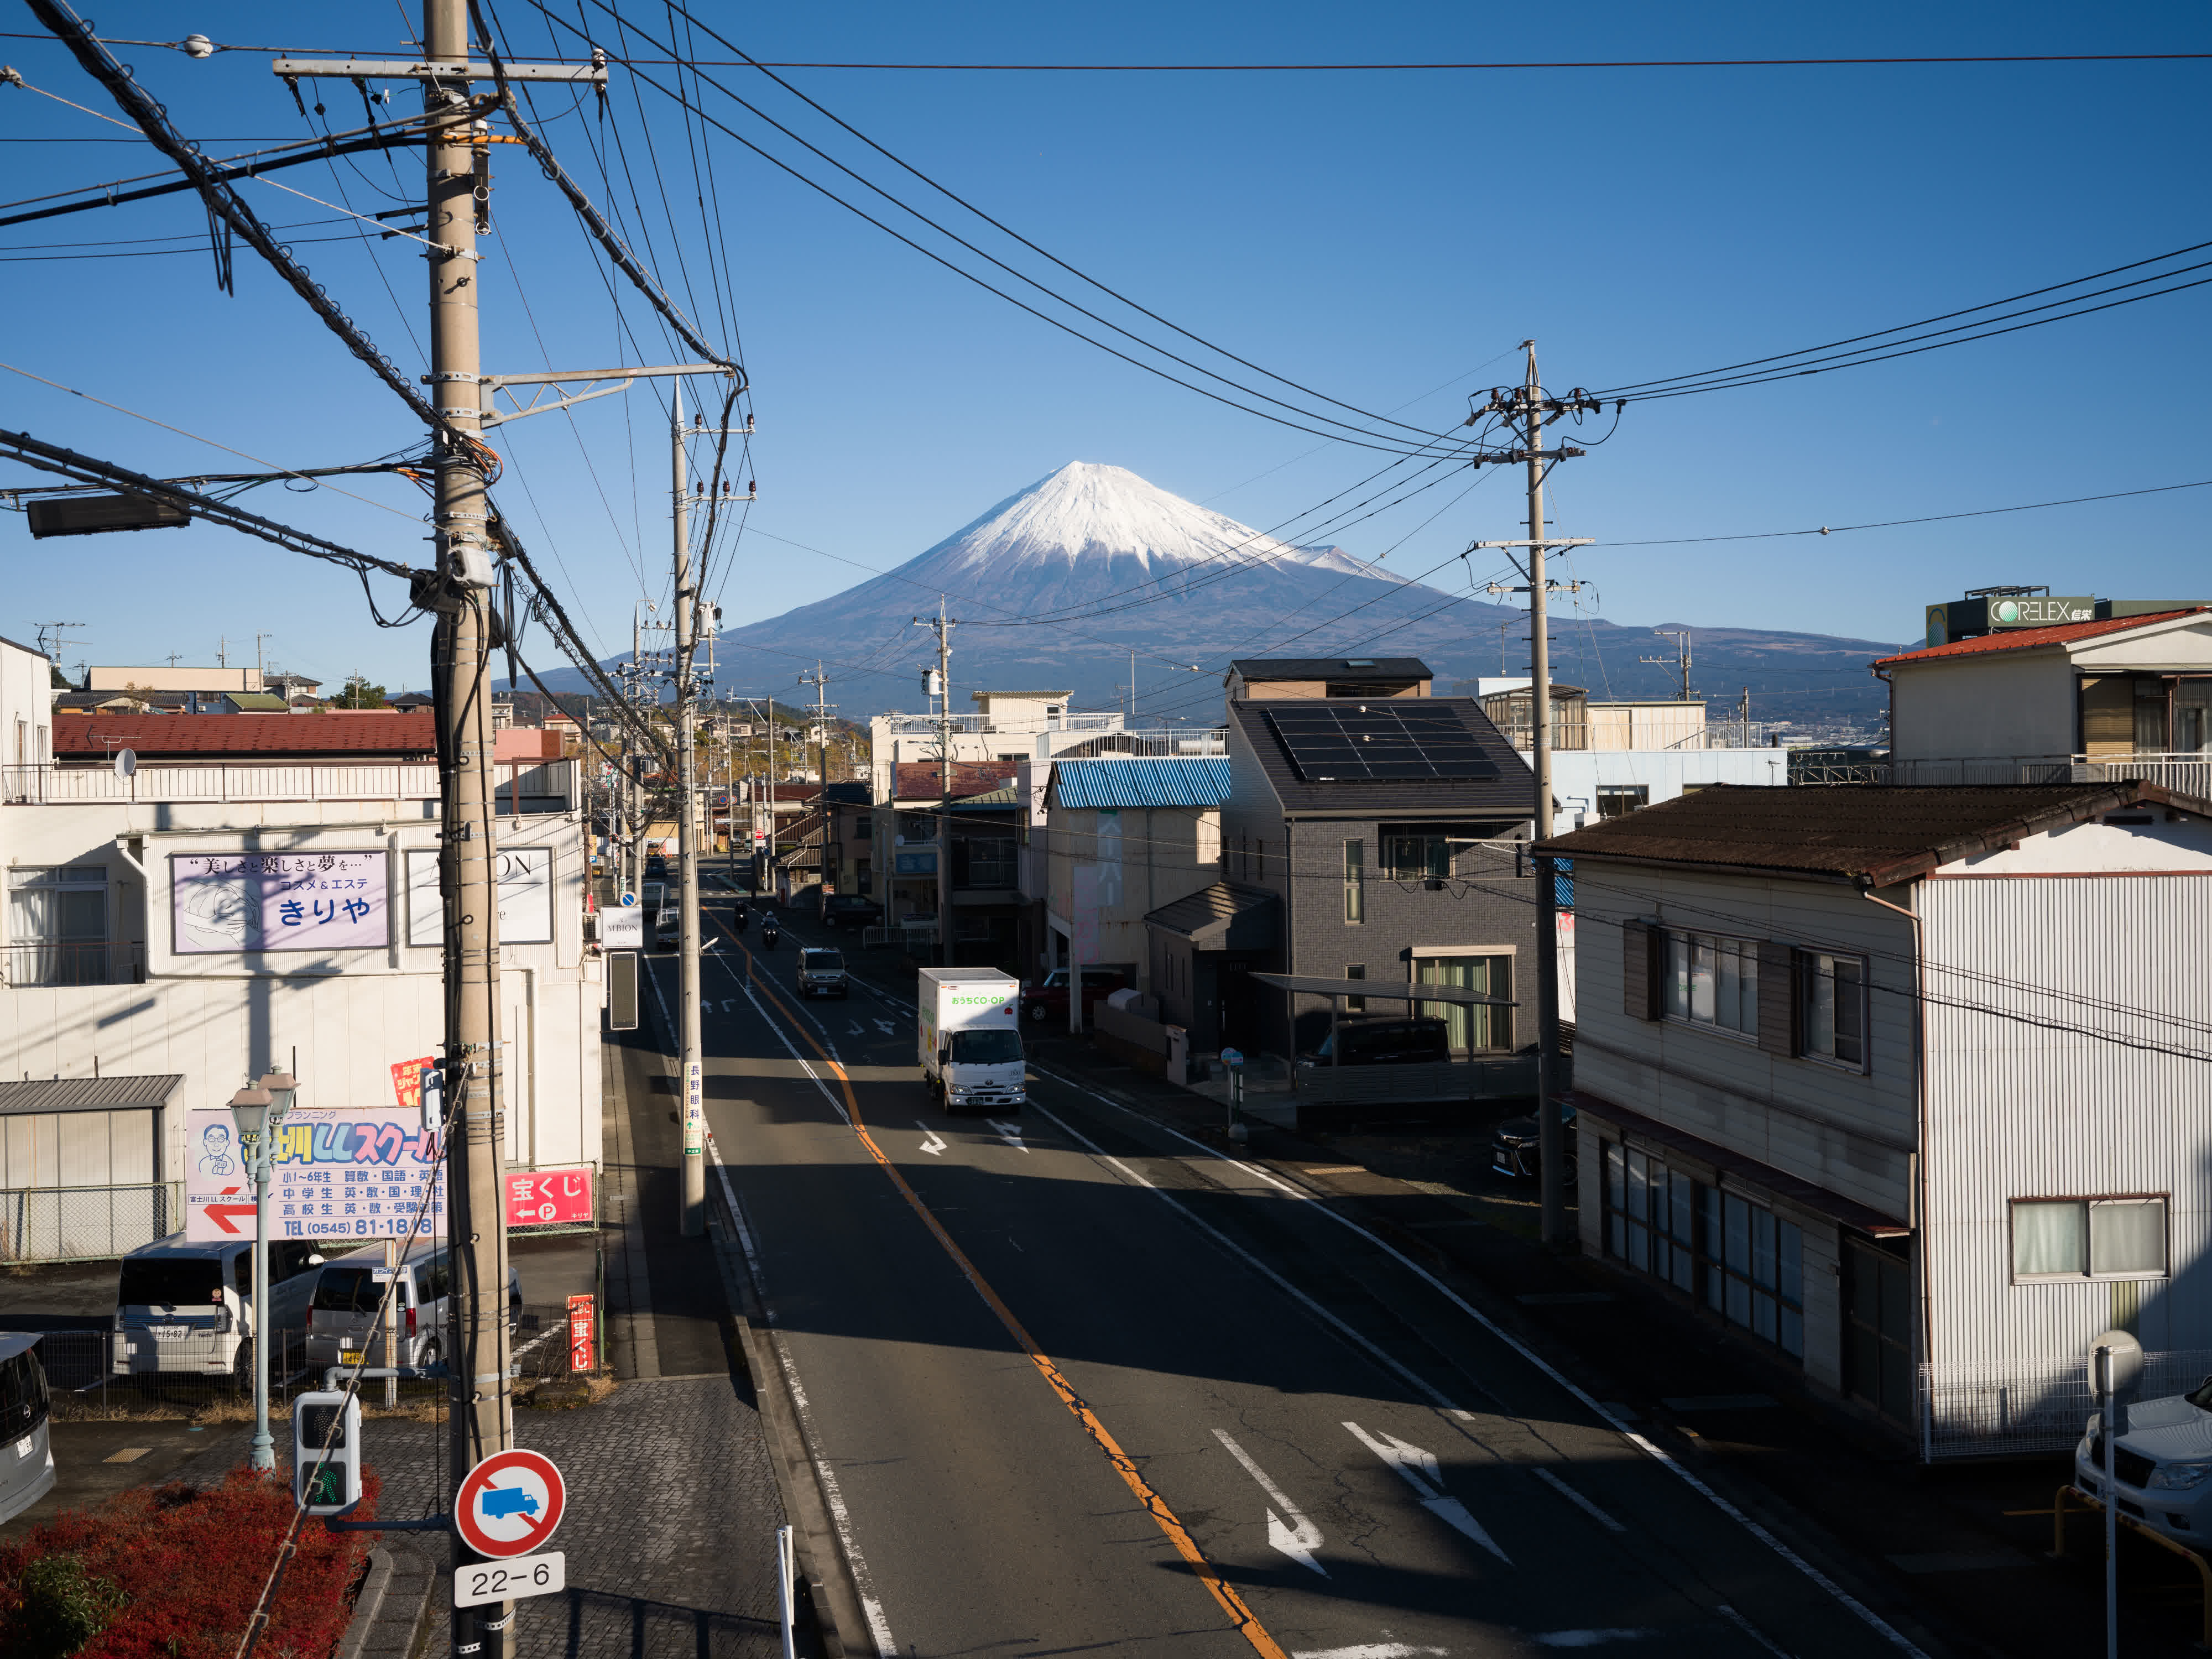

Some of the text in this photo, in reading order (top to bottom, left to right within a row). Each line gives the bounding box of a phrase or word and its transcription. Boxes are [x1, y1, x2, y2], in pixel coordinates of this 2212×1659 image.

[1990, 601, 2070, 623] CORELEX
[281, 879, 368, 891] コスメ&エステ
[279, 897, 371, 926] きりや
[690, 1065, 700, 1120] 長野眼科
[239, 1122, 447, 1166] 士川LLスクール
[283, 1187, 332, 1199] 中学生
[512, 1176, 581, 1201] 宝くじ
[283, 1203, 332, 1215] 高校生
[543, 1206, 553, 1218] P
[284, 1220, 304, 1236] TEL
[307, 1222, 351, 1234] (0545)
[573, 1322, 588, 1369] 宝くじ
[472, 1563, 550, 1596] 22-6
